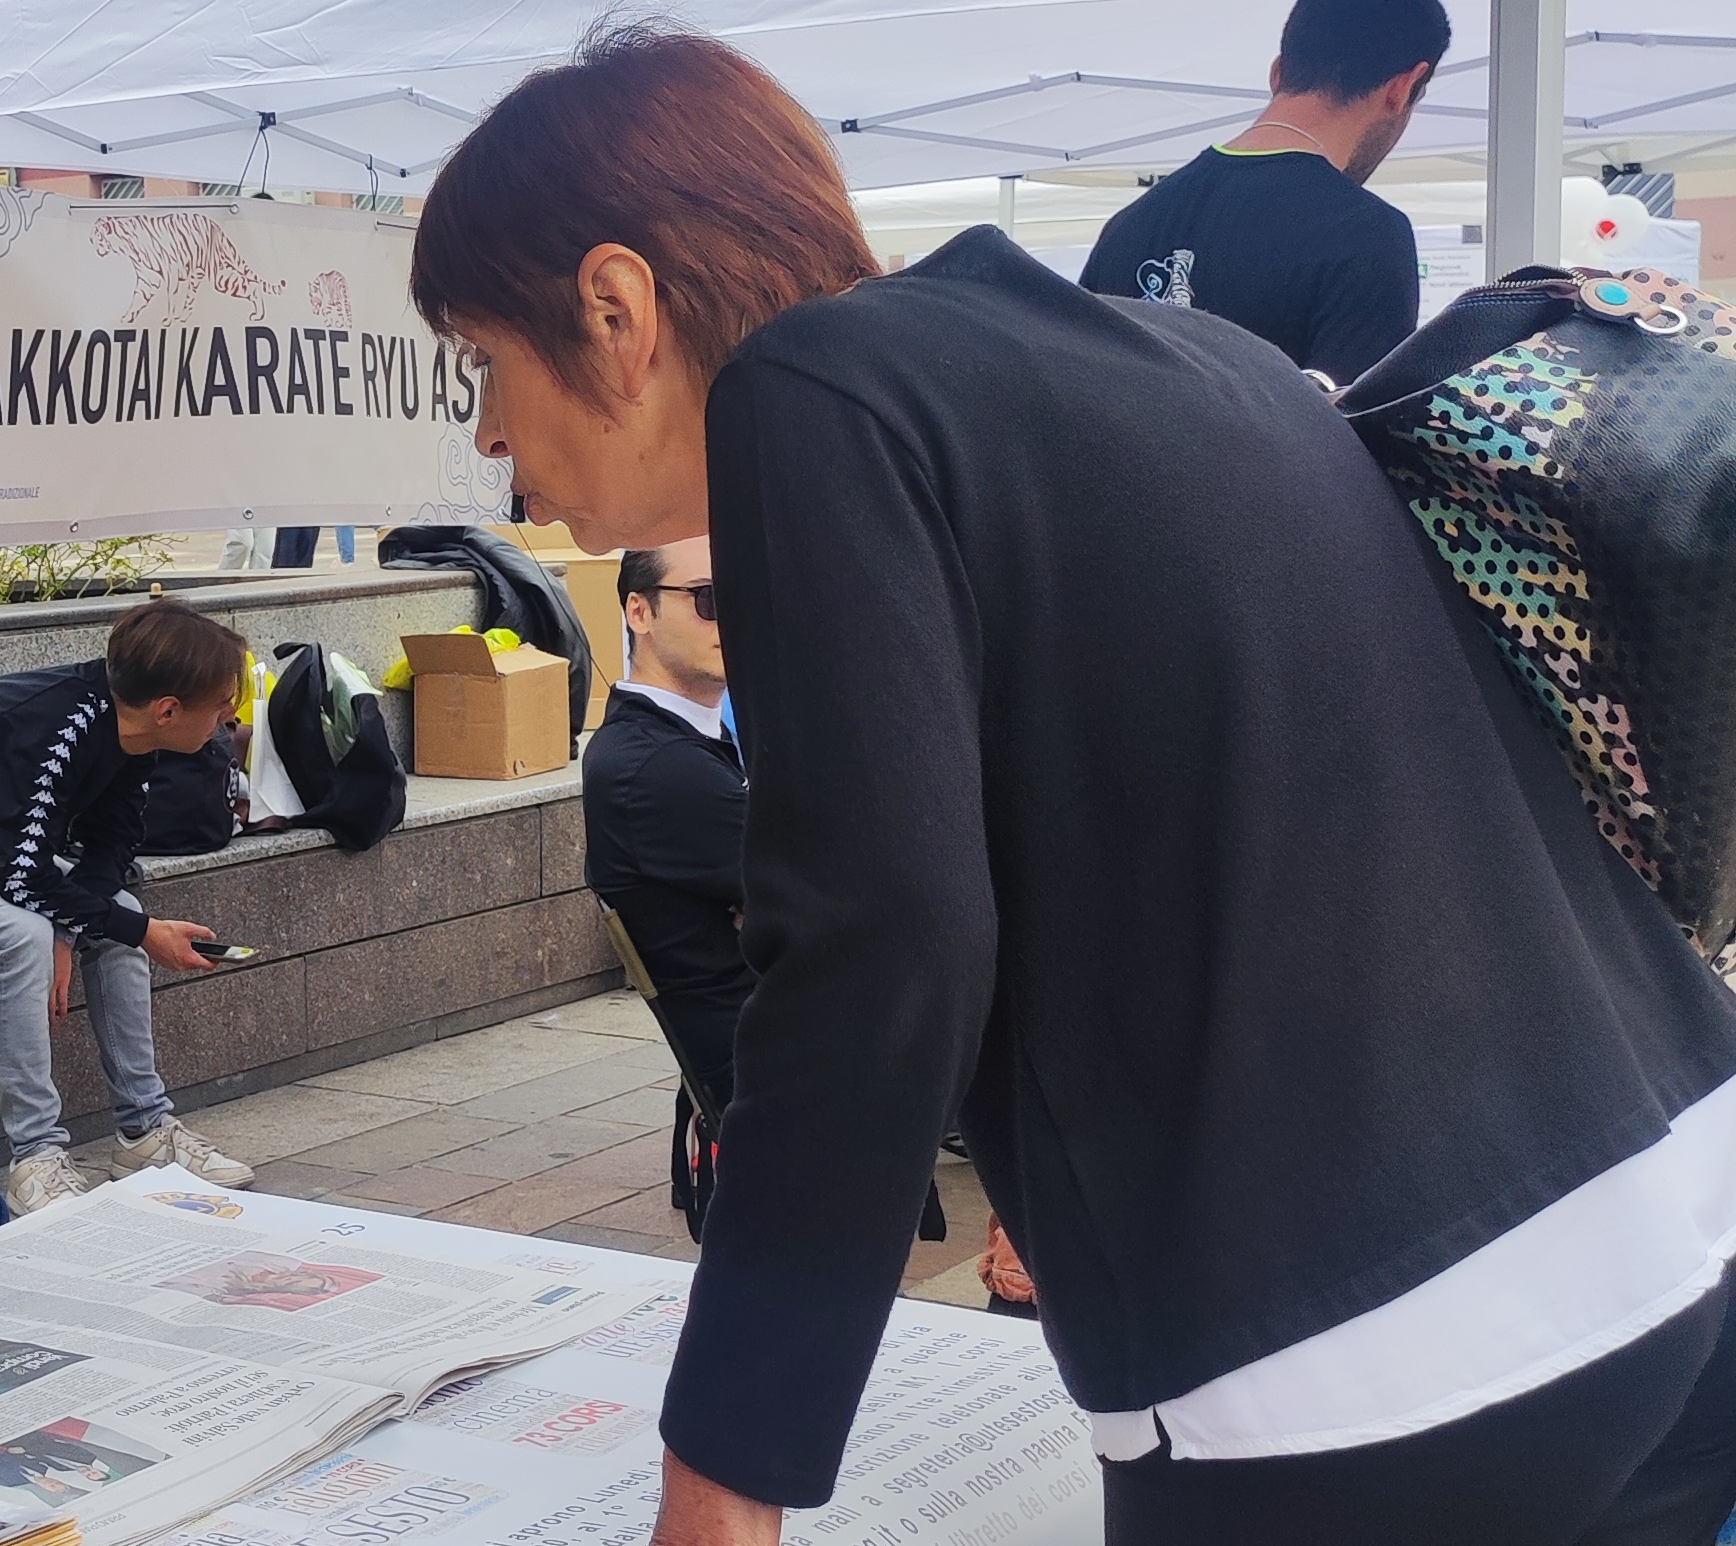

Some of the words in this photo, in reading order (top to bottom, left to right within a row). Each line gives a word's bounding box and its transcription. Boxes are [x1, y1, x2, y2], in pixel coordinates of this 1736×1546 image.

[174, 326, 354, 417] KARATE
[363, 332, 420, 421] RYU
[431, 339, 489, 423] AS
[899, 1324, 933, 1339] via
[900, 1331, 968, 1365] qualche
[858, 1391, 906, 1413] della
[958, 1337, 1006, 1361] corsi
[890, 1407, 918, 1422] in
[912, 1396, 944, 1411] tre
[939, 1360, 1006, 1397] trimestri
[1001, 1343, 1042, 1365] fino
[453, 1387, 557, 1431] cinema
[514, 1432, 564, 1448] 73
[543, 1400, 630, 1433] CORSI
[838, 1430, 931, 1481] iscrizione
[927, 1383, 1018, 1429] telefonate
[1016, 1362, 1055, 1382] allo
[811, 1505, 861, 1534] mail
[882, 1383, 1074, 1495] segreteria@utesestosg
[899, 1517, 919, 1535] o
[917, 1488, 968, 1524] sulla
[964, 1456, 1025, 1498] nostra
[1021, 1424, 1080, 1471] pagina
[279, 1461, 410, 1517] religioni
[324, 1485, 471, 1545] SESTO
[1017, 1486, 1050, 1521] dei
[1046, 1460, 1092, 1502] corsi
[508, 1505, 587, 1543] aprono
[577, 1521, 607, 1535] al
